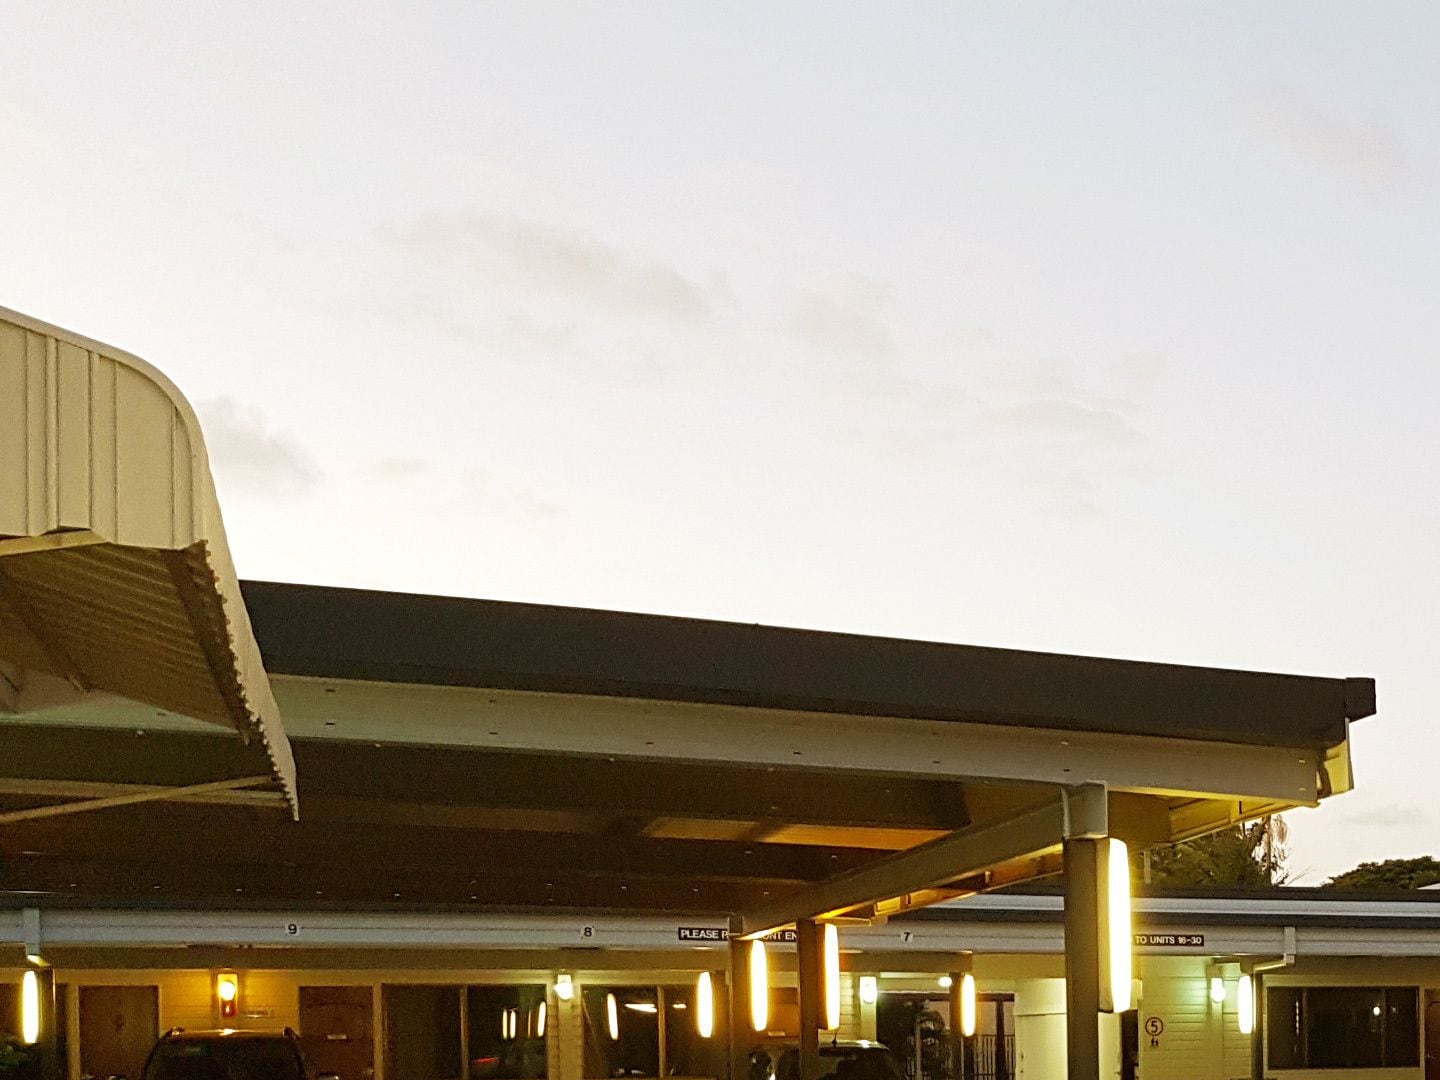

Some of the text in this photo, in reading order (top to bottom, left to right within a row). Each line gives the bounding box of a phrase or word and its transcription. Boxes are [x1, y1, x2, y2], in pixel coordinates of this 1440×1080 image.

[287, 923, 298, 935] 9
[584, 926, 593, 937] 8
[680, 929, 719, 940] PLEASE
[903, 931, 911, 942] 7
[1134, 935, 1147, 944] TO
[1149, 935, 1176, 945] UNITS
[1150, 1020, 1158, 1033] 5
